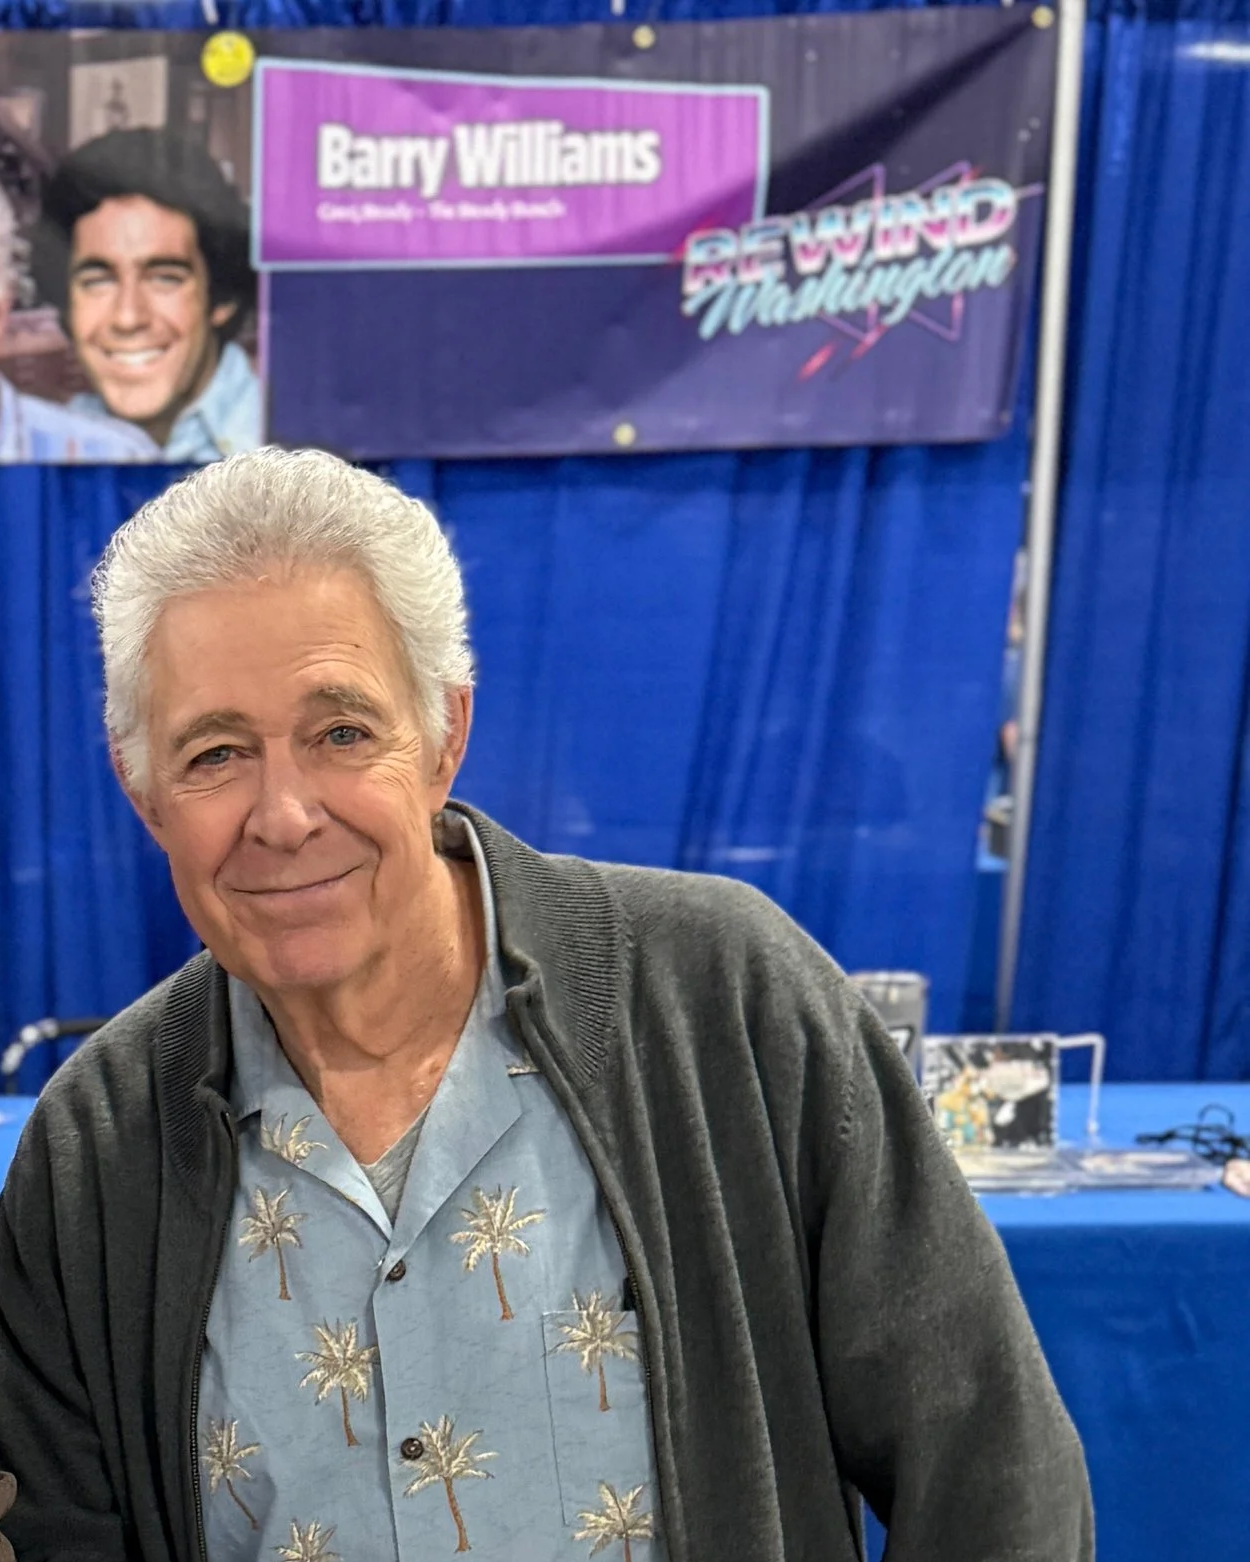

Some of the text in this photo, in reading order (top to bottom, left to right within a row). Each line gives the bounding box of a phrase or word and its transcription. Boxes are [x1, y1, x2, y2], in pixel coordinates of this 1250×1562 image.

[318, 120, 662, 199] Barry Williams
[682, 177, 1017, 298] REWIND
[681, 245, 1014, 340] Washington
